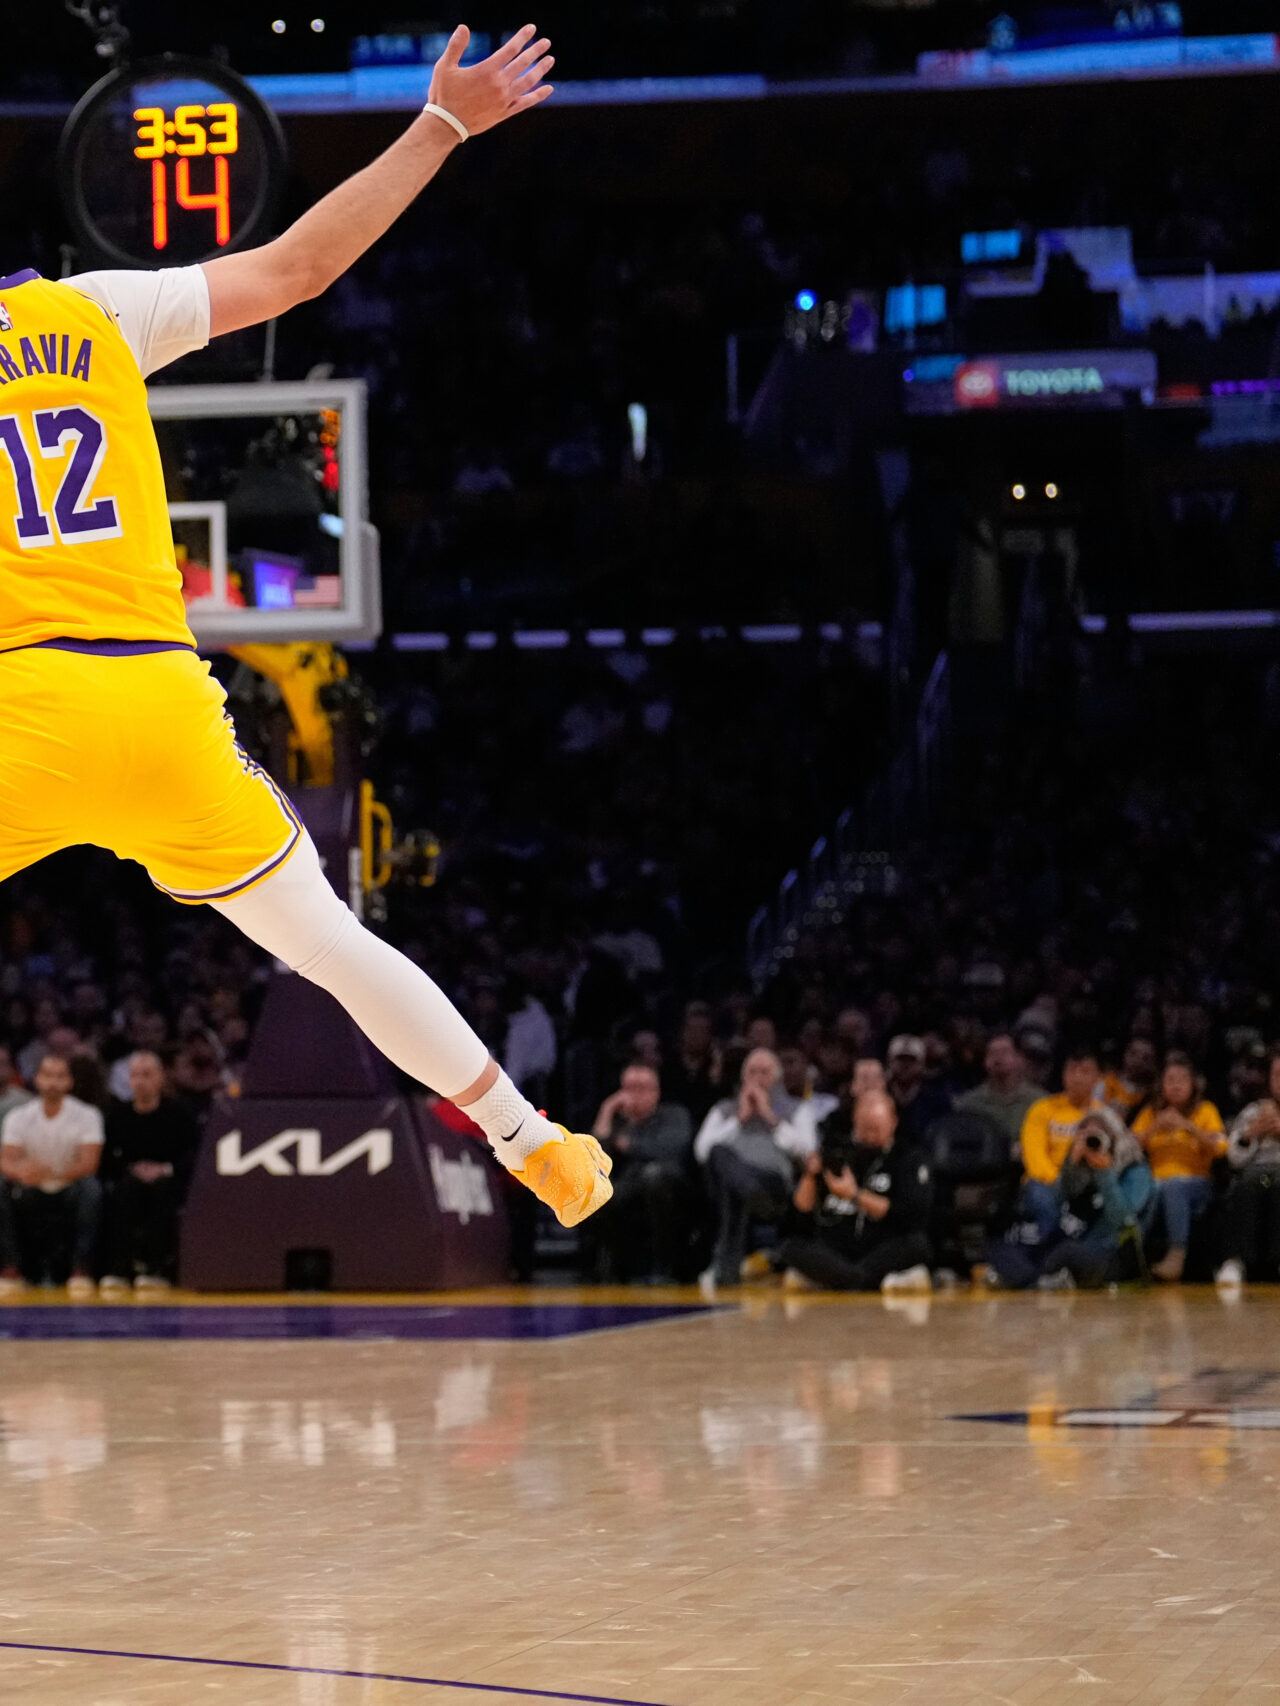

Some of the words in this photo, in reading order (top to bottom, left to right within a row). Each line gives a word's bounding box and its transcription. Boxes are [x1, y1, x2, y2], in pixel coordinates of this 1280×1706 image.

[133, 103, 238, 159] 3:53
[152, 155, 230, 250] 14
[1006, 367, 1104, 396] TOYOTA
[216, 1128, 393, 1176] KIA
